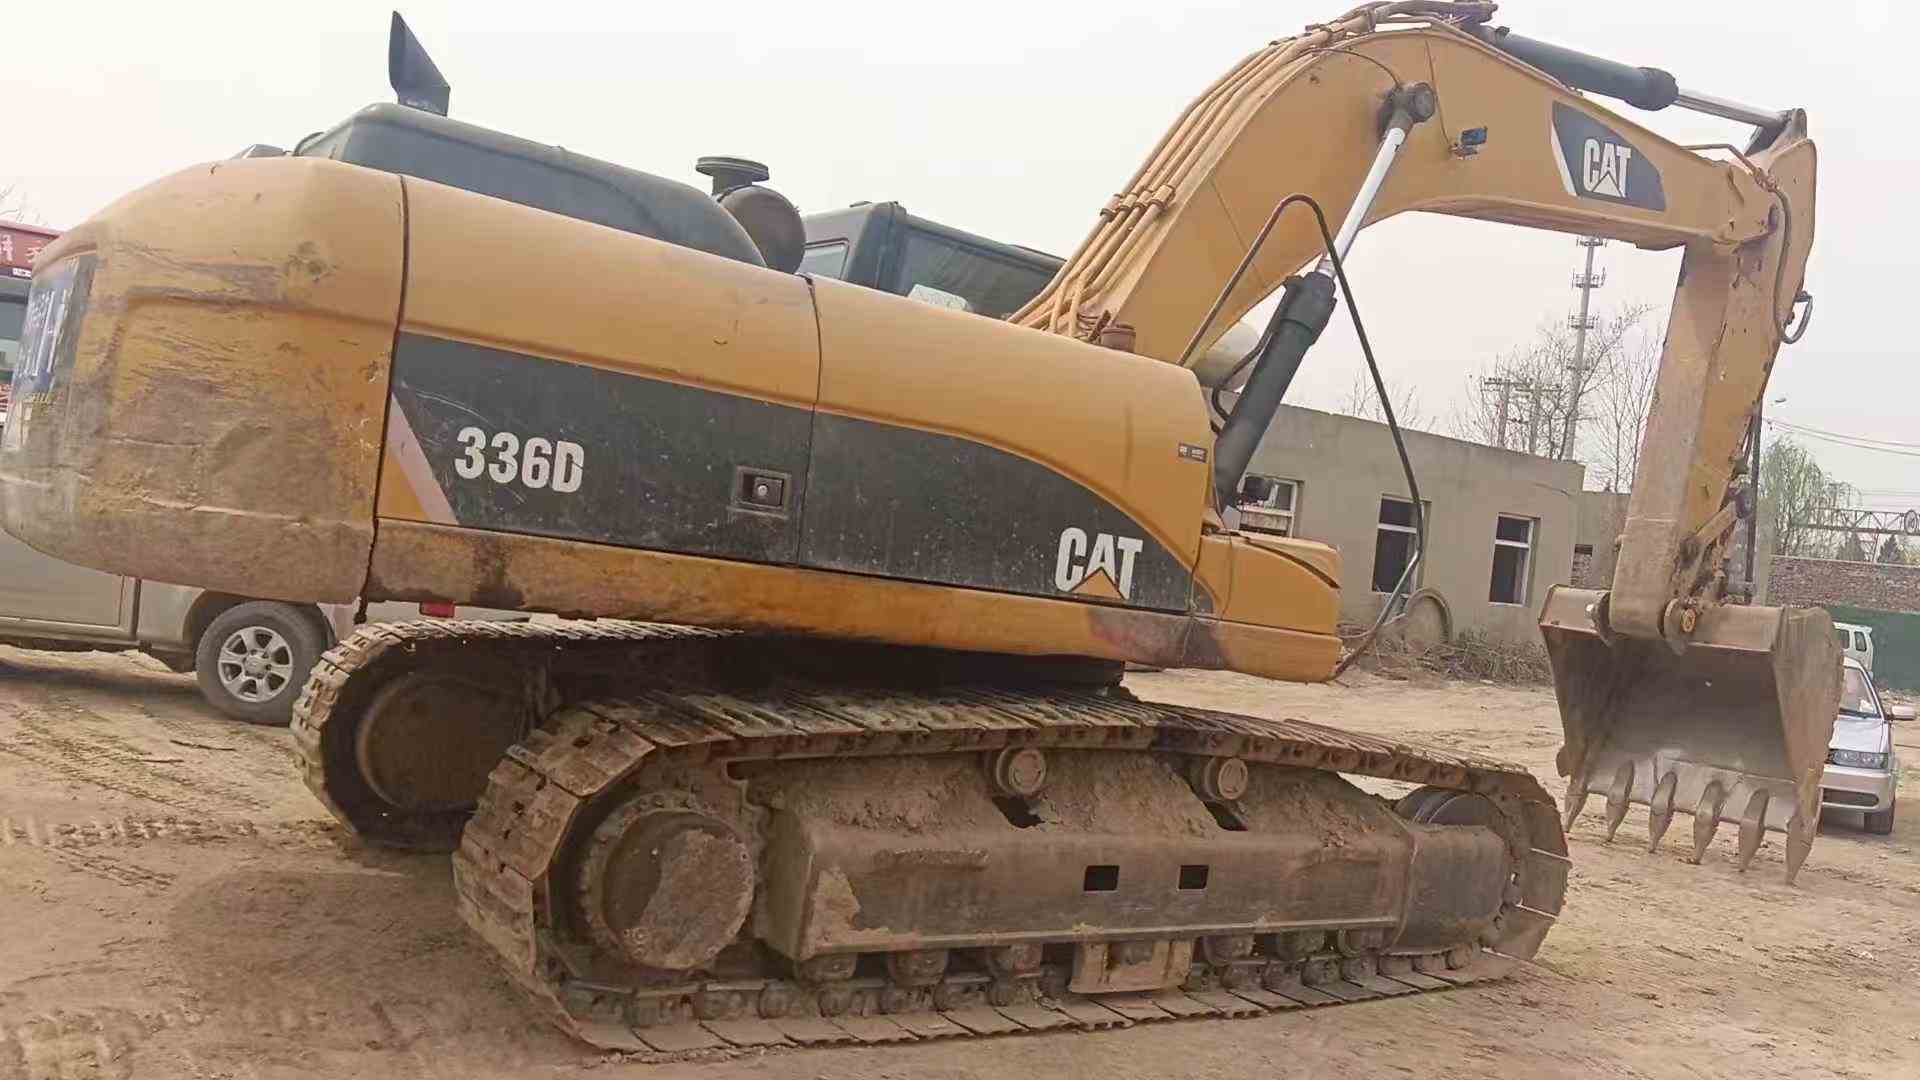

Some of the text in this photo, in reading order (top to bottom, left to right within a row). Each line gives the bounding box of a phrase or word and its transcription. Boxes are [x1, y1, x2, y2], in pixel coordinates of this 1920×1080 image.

[1583, 138, 1631, 198] CAT
[455, 426, 584, 493] 336D
[1055, 527, 1143, 600] CAT
